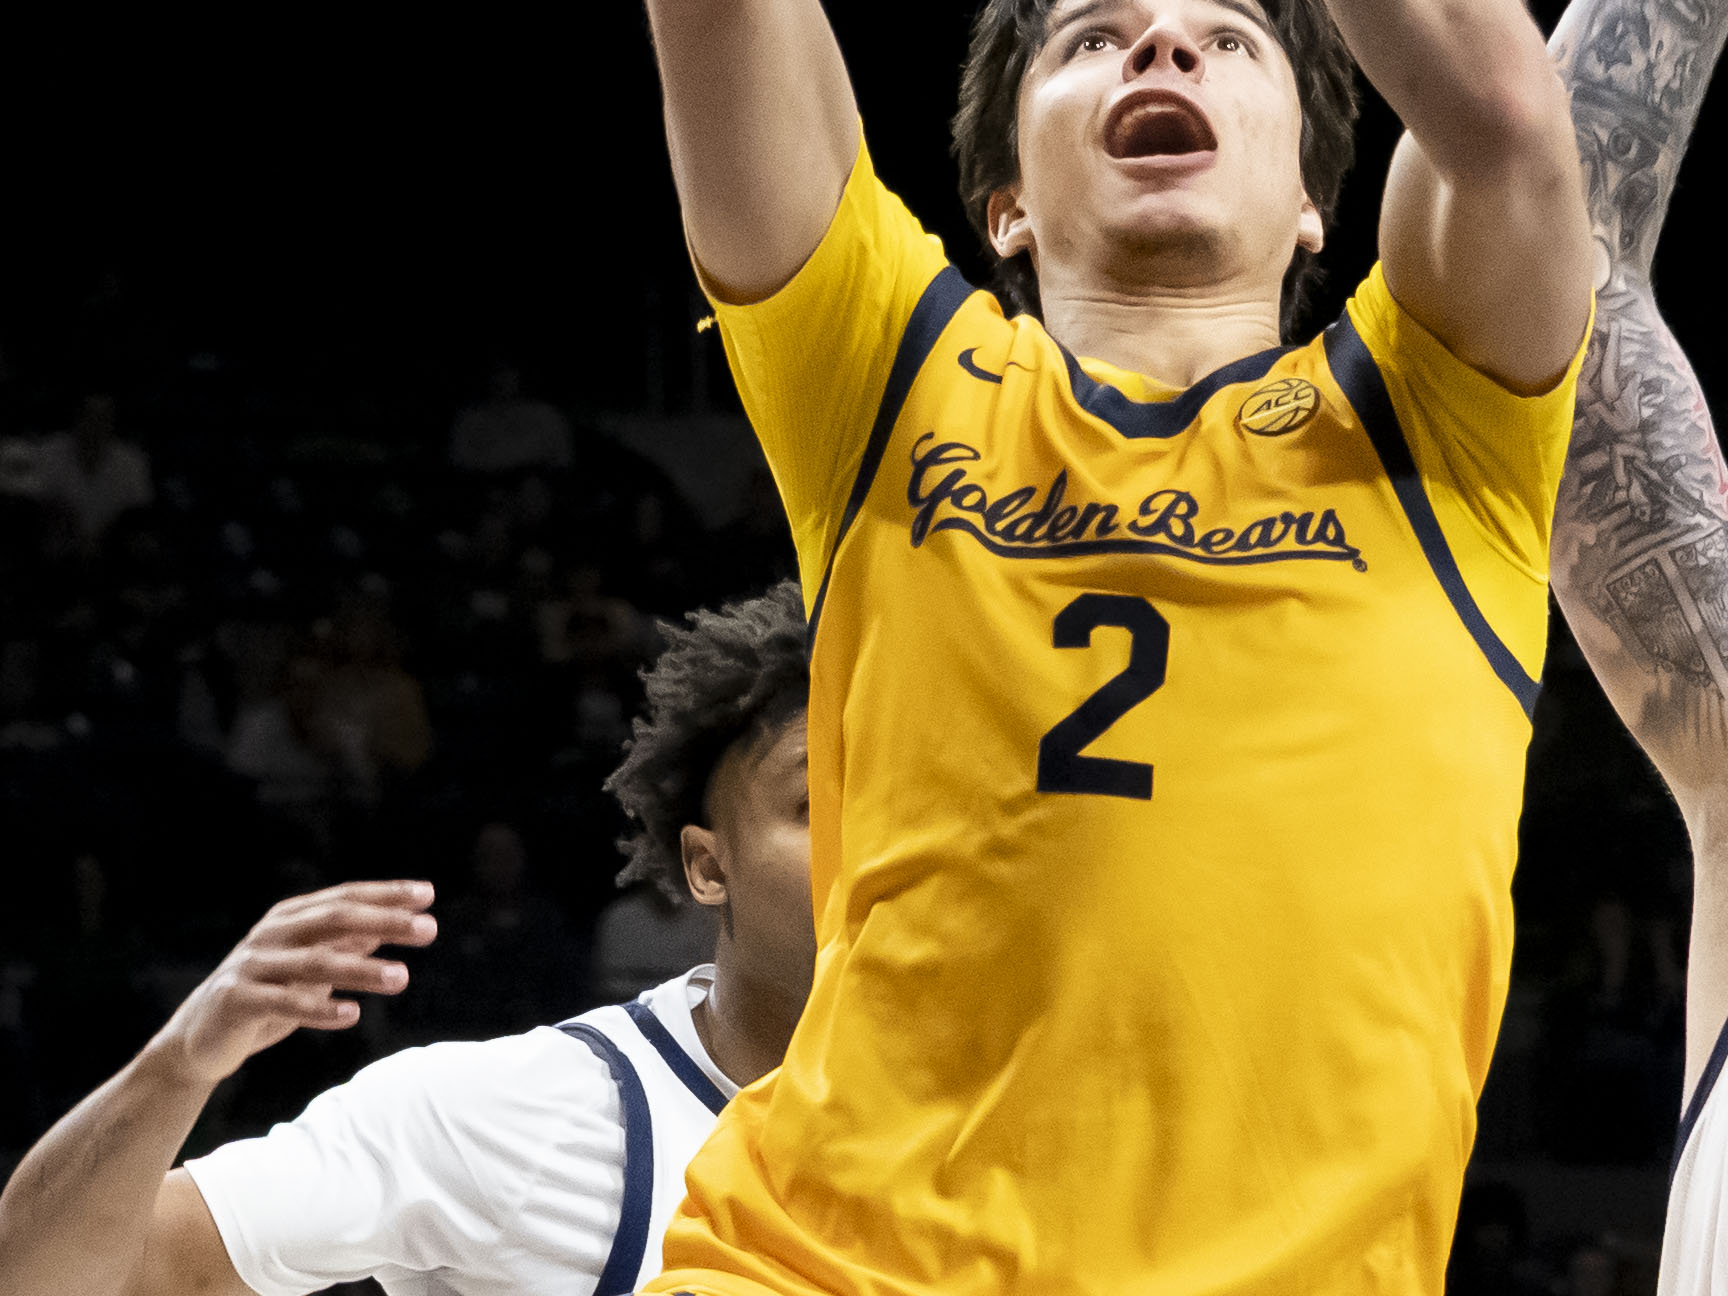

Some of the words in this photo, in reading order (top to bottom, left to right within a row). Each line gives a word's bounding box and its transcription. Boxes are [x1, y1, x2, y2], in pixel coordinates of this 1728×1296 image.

[1254, 390, 1315, 415] ACC
[907, 432, 1119, 548] Golden
[1127, 489, 1358, 556] Bears
[1037, 593, 1170, 800] 2
